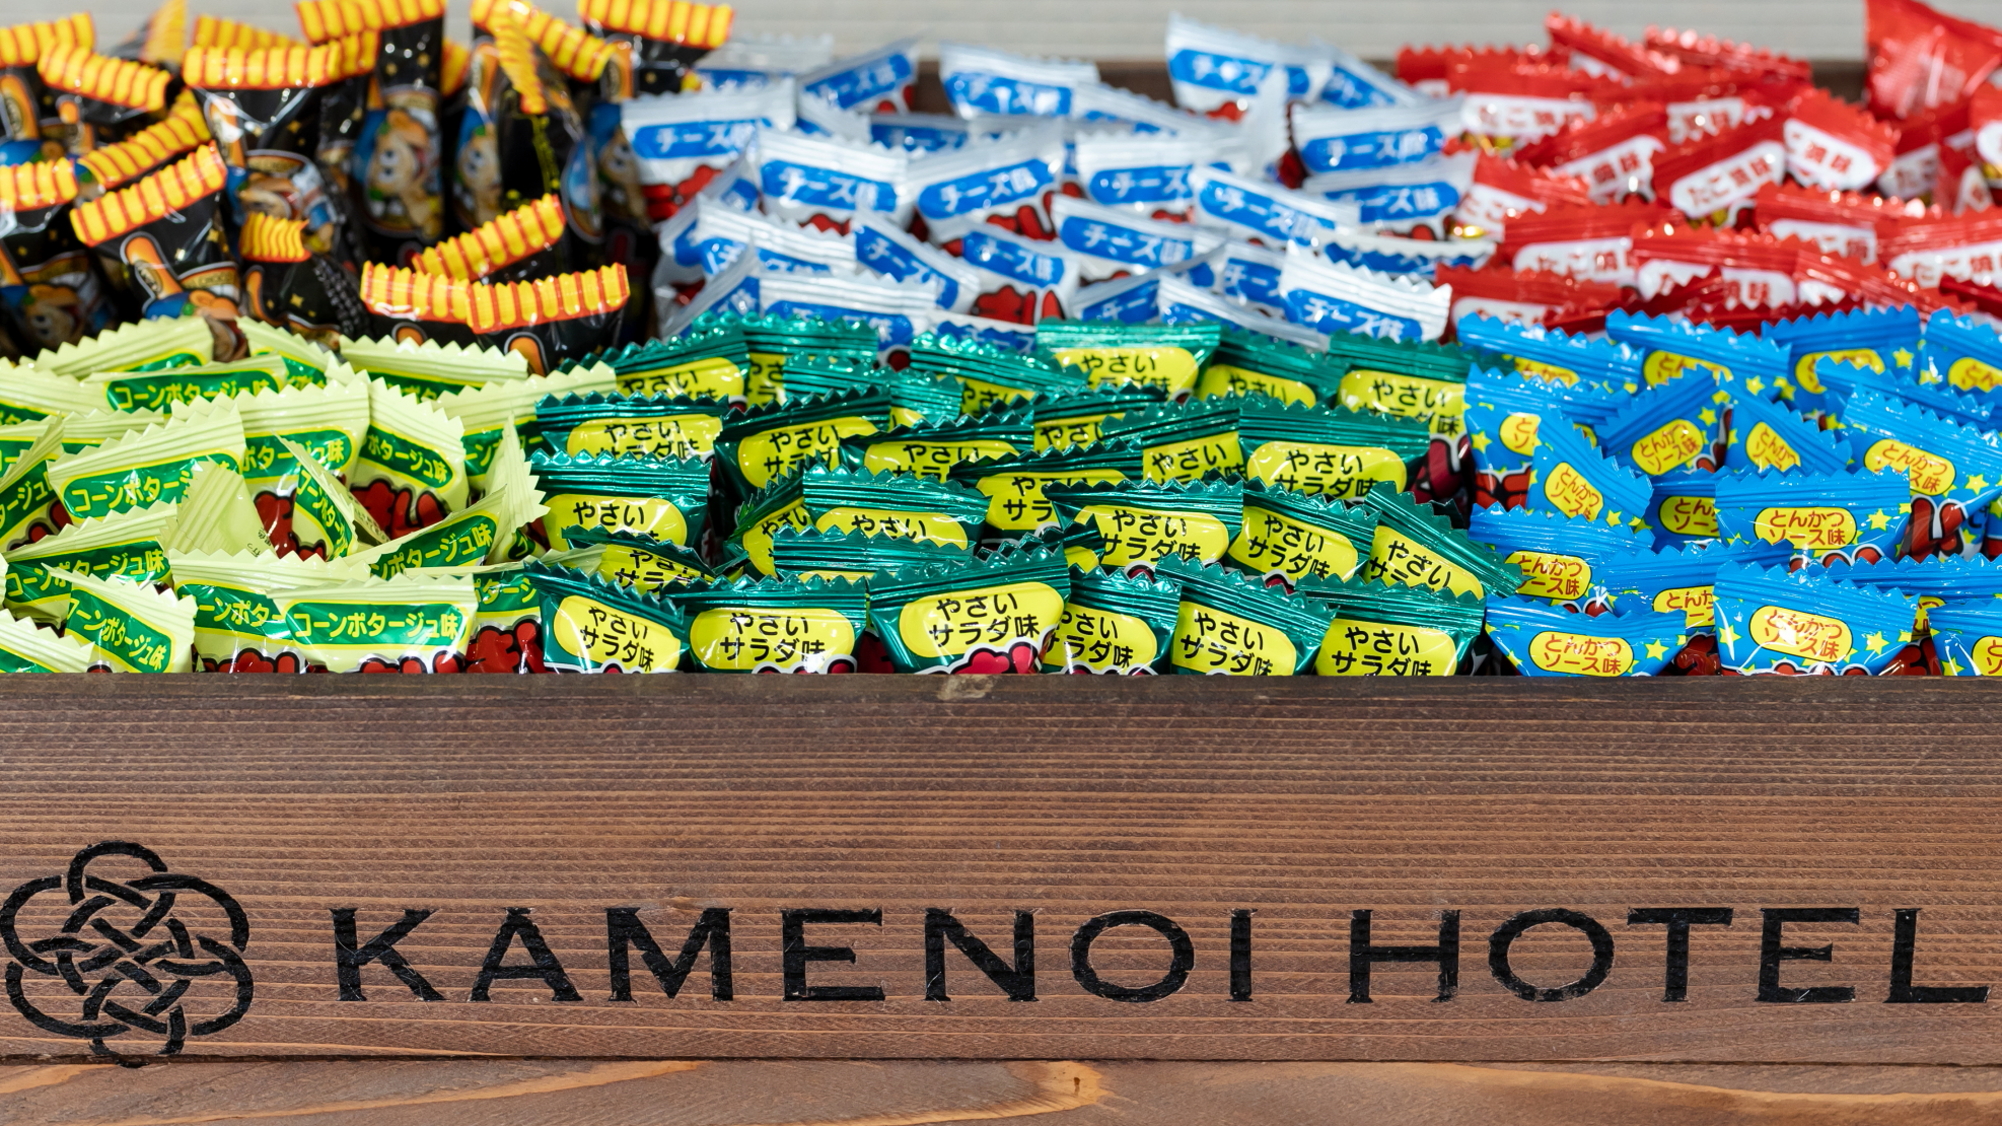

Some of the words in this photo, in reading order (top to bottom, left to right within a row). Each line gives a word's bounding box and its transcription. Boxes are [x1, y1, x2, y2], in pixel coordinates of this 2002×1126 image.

[1084, 226, 1191, 266] チーズ味
[1082, 355, 1156, 374] やさい
[623, 371, 698, 396] やさい
[1373, 378, 1446, 409] やさい
[605, 420, 681, 443] やさい
[770, 425, 839, 453] やさい
[903, 444, 979, 464] やさい
[1152, 444, 1227, 475] やさい
[1286, 450, 1363, 474] やさい
[1883, 444, 1948, 477] とんかつ
[573, 501, 644, 526] やさい
[1003, 499, 1053, 522] サラ
[1112, 510, 1187, 538] やさい
[1769, 510, 1845, 529] とんかつ
[1103, 534, 1202, 562] サラダ味
[1265, 515, 1324, 553] やさい
[1769, 528, 1847, 547] ソース味
[1247, 535, 1331, 580] サラダ味
[1388, 540, 1451, 588] やさい
[1519, 555, 1583, 578] とんかつ
[936, 593, 1018, 621] やさい
[293, 612, 459, 639] コーンポタージュ味
[589, 606, 648, 640] やさい
[730, 612, 809, 635] やさい
[929, 613, 1040, 649] サラダ味
[1194, 611, 1264, 651] やさい
[580, 625, 655, 672] サラダ味
[719, 636, 826, 663] サラダ味
[1180, 633, 1274, 676] サラダ味
[1345, 626, 1420, 656] やさい
[1544, 633, 1622, 657] とんかつ
[1331, 650, 1432, 676] サラダ味
[1544, 651, 1622, 675] ソース味
[329, 906, 1257, 1003] KAMENOI
[1345, 906, 1991, 1004] HOTEL
